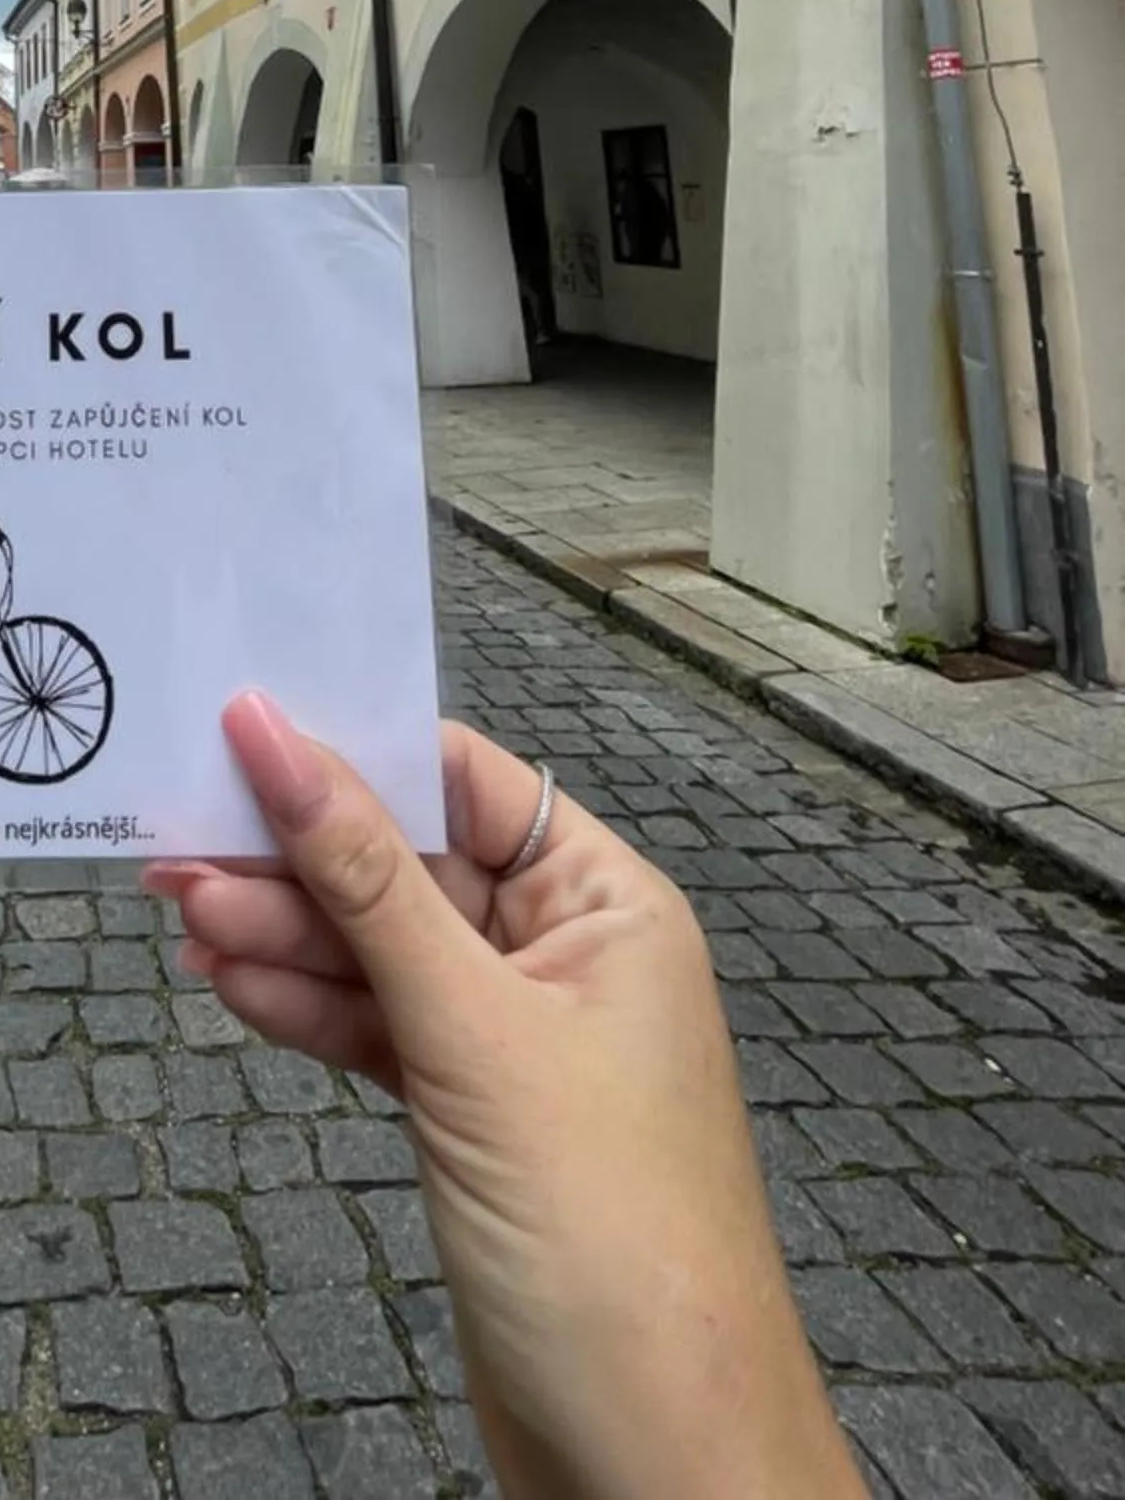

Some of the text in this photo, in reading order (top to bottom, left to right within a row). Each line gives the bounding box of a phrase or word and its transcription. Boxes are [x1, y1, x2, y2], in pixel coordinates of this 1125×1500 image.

[49, 311, 191, 363] KOL
[51, 402, 189, 431] ZAPŮJČENÍ
[203, 407, 247, 426] KOL
[49, 439, 147, 460] HOTELU
[5, 815, 155, 845] nejkrásnější...
